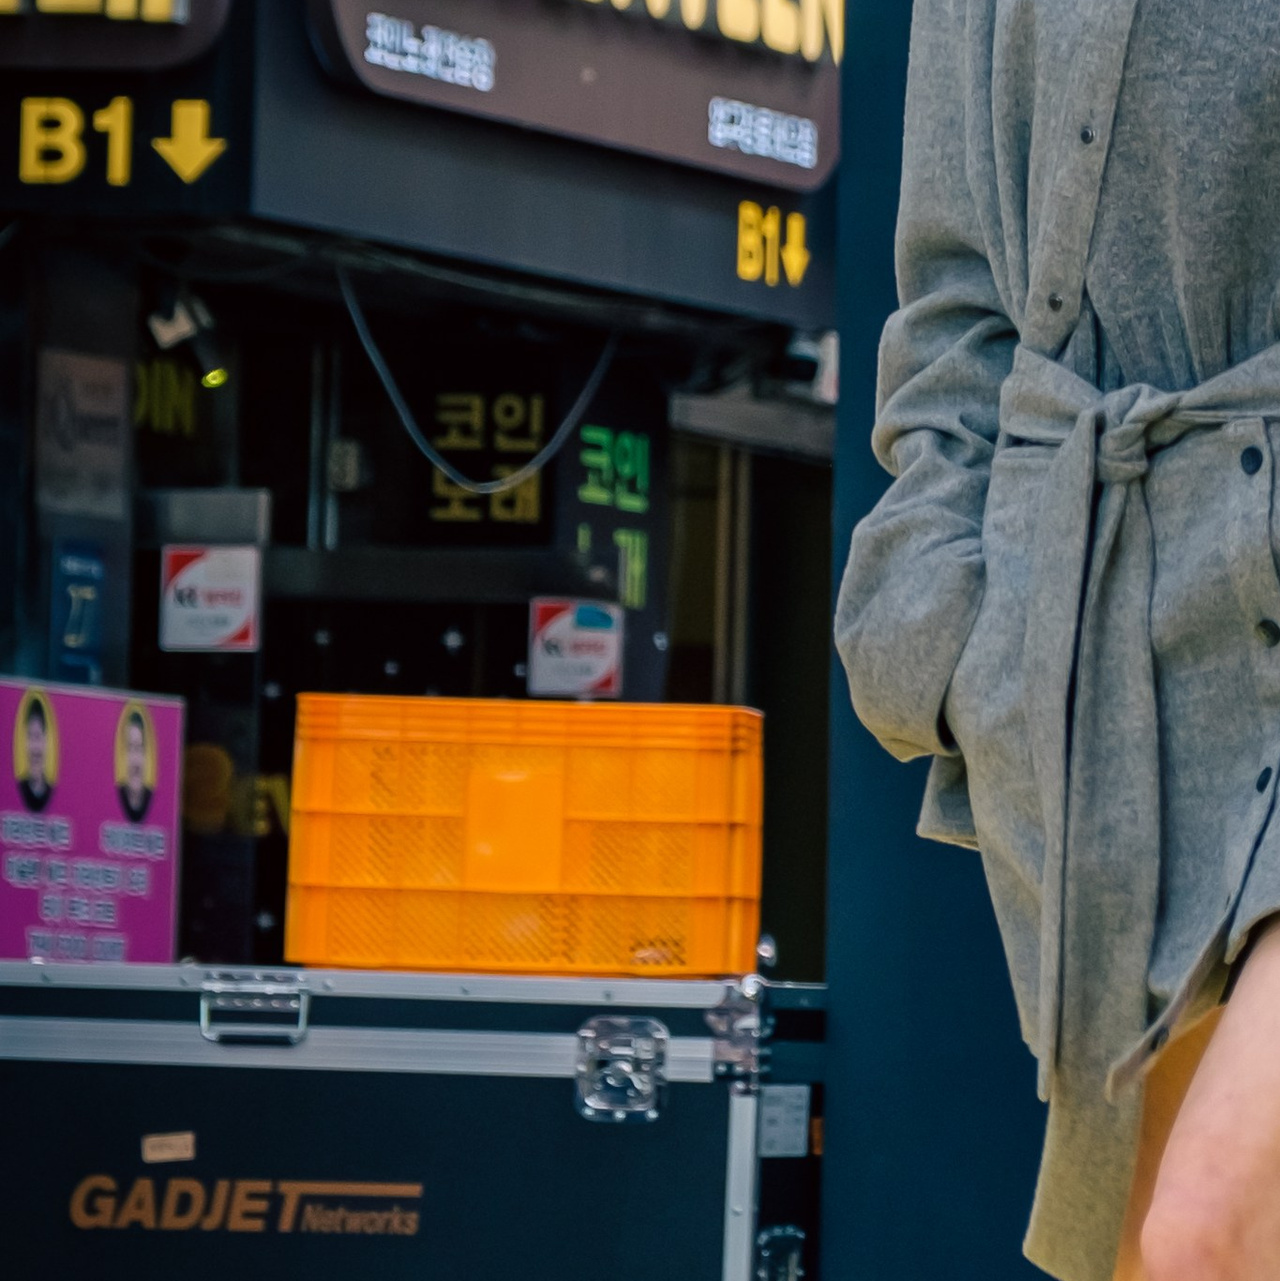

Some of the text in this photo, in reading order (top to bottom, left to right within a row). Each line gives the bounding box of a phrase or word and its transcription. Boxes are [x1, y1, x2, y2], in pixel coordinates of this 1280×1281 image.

[19, 96, 132, 186] B1
[737, 201, 780, 285] B1
[433, 391, 545, 452] 코인
[69, 1175, 422, 1235] GADJET Networks
